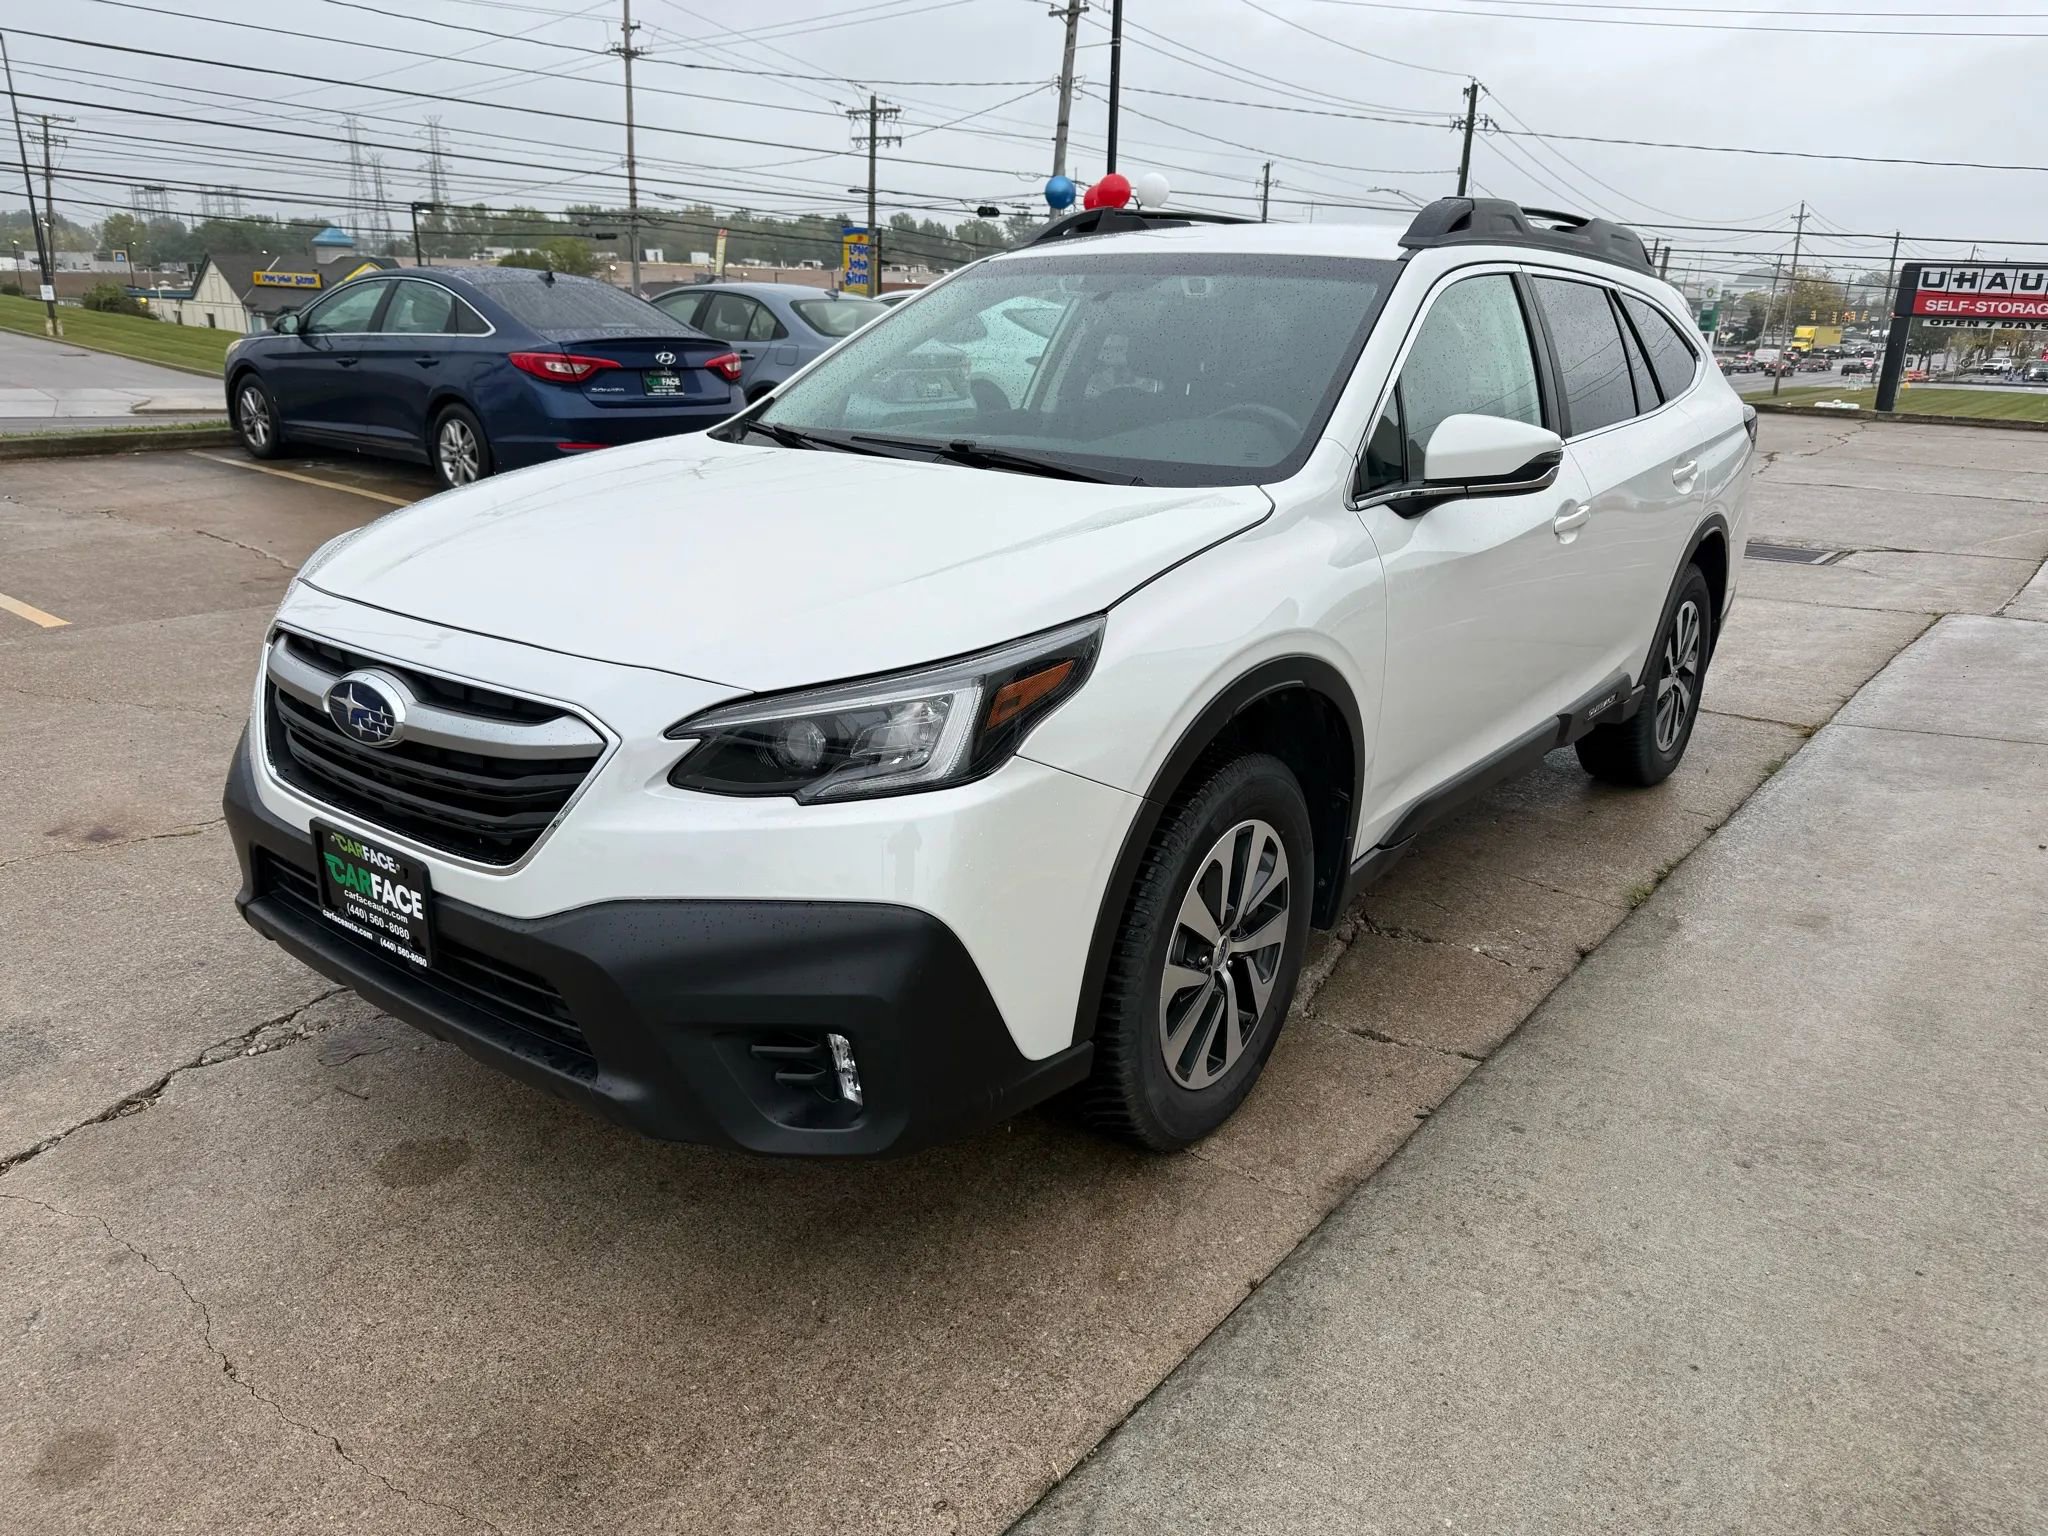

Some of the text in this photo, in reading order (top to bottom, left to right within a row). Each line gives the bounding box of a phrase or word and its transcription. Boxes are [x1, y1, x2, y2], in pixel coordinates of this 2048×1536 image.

[1929, 319, 1979, 328] OPEN
[333, 832, 397, 874] CARFACE
[323, 851, 424, 920] CARFACE
[344, 889, 408, 924] carfaceauto.com
[346, 903, 367, 922] (440)
[322, 909, 373, 940] carfaceauto.com
